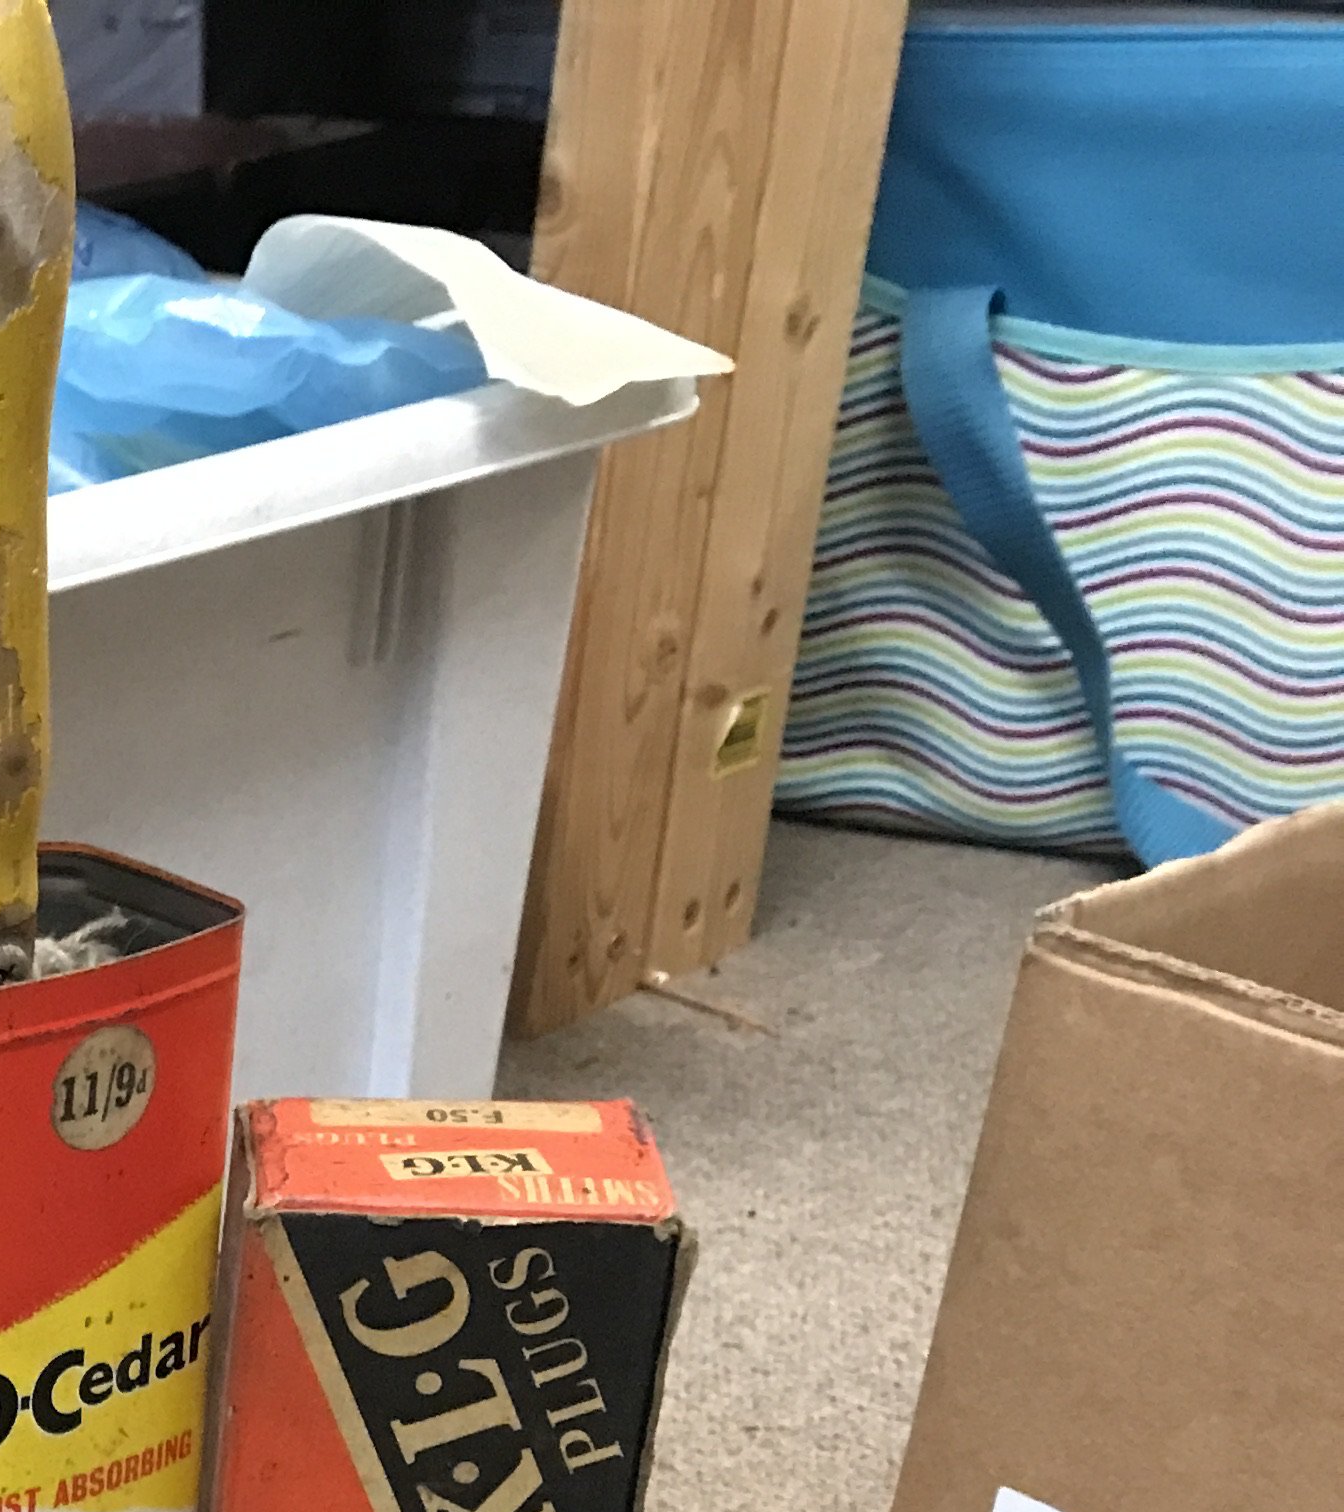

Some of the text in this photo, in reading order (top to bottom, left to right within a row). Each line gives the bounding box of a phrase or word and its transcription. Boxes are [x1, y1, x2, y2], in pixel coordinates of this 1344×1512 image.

[294, 1131, 418, 1147] PLUGS
[496, 1175, 661, 1207] SMITHS
[488, 1246, 625, 1474] PLUGS
[52, 1428, 194, 1512] ABSORBING
